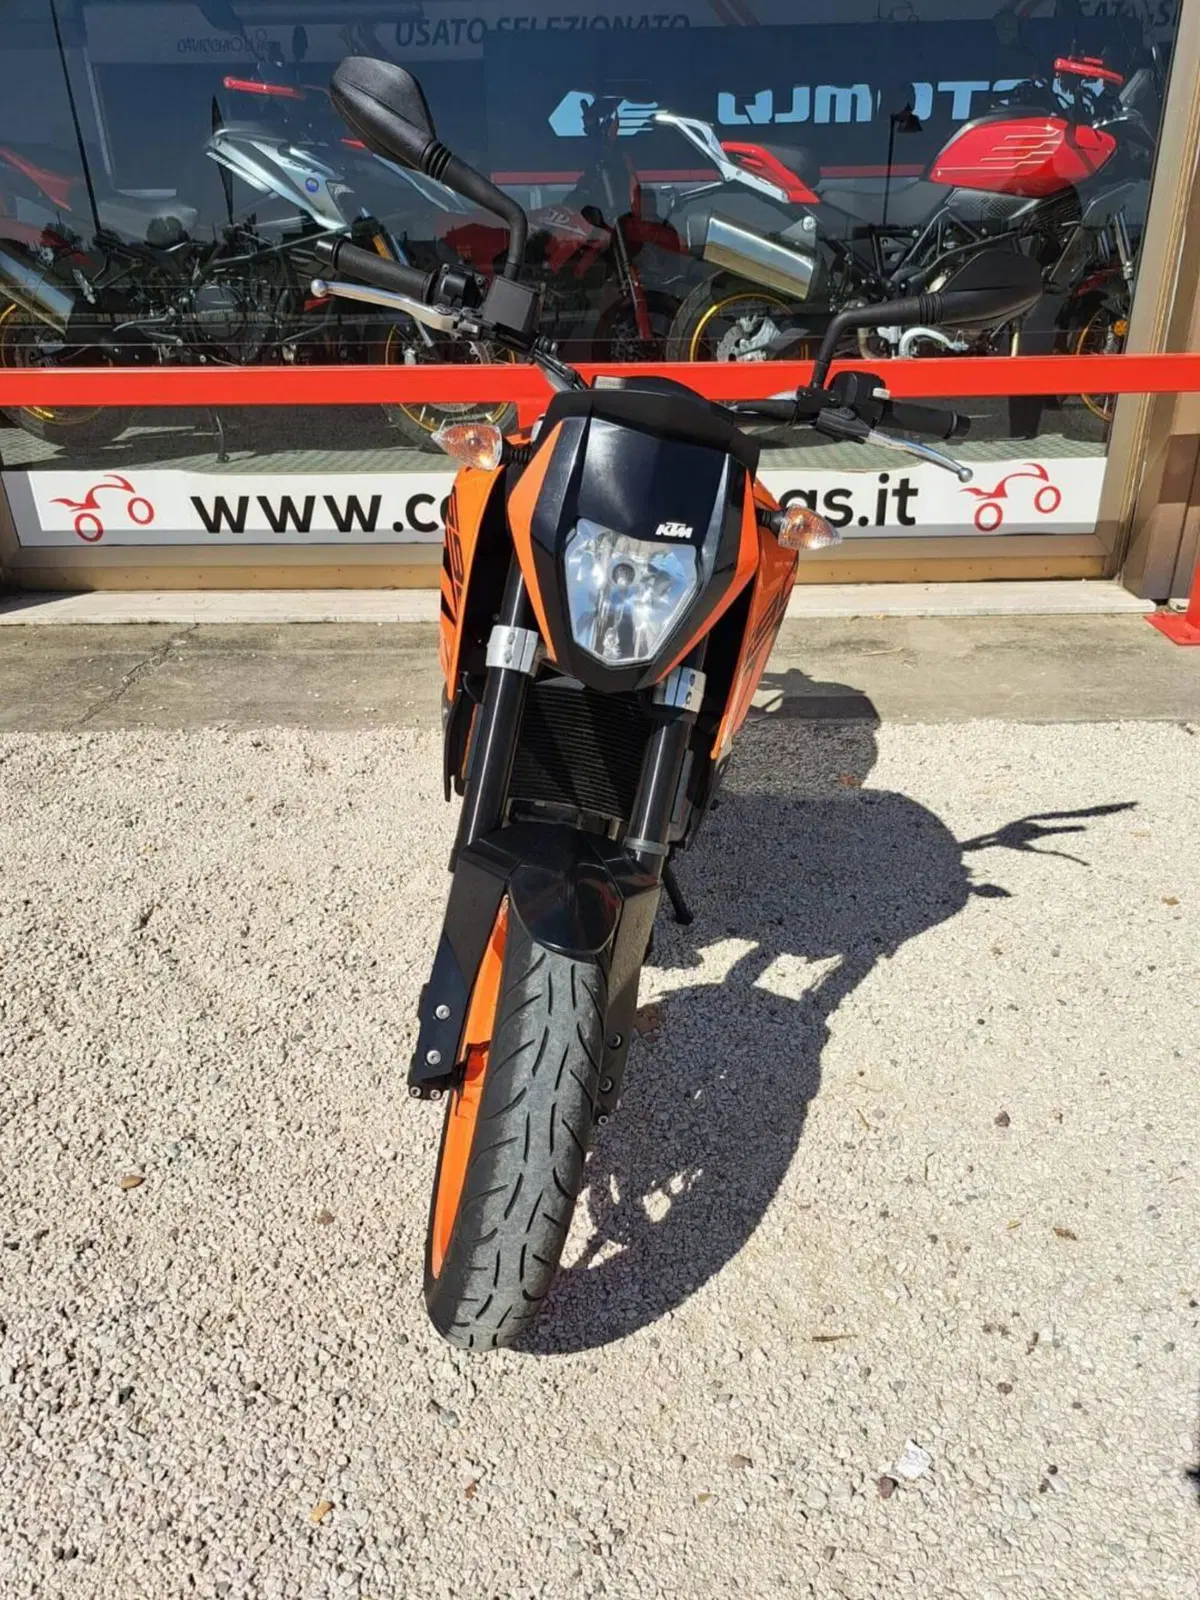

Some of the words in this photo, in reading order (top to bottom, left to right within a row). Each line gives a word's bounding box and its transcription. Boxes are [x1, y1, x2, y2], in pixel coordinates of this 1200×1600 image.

[394, 17, 488, 47] USATO
[189, 493, 454, 534] www.c
[655, 521, 694, 539] KTM
